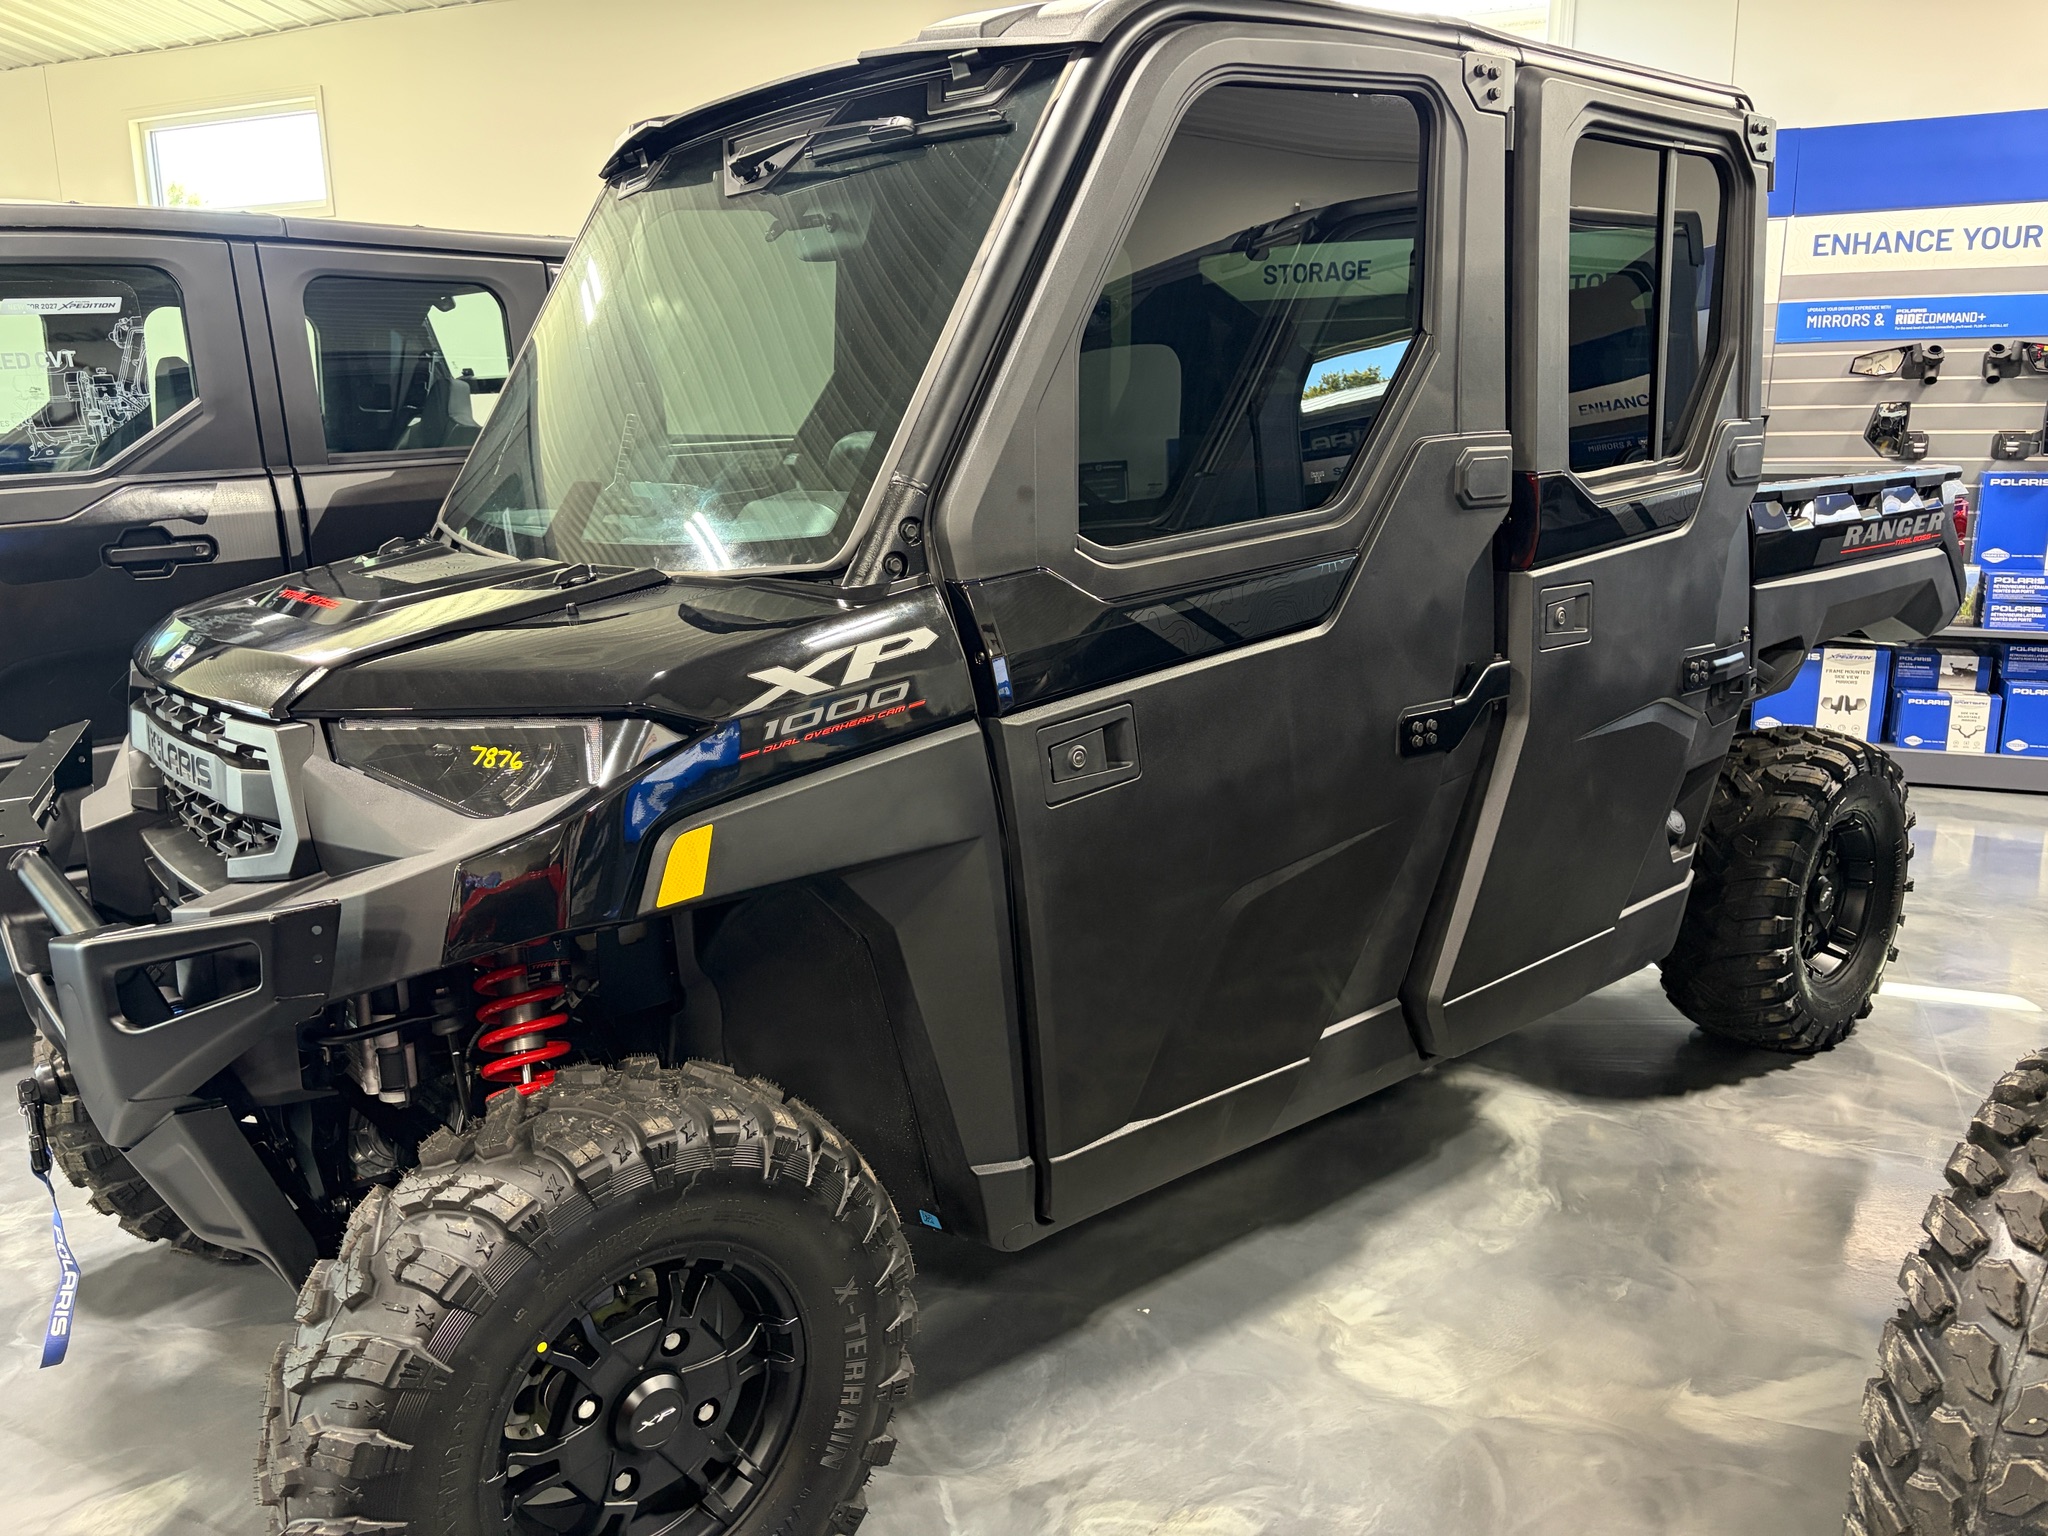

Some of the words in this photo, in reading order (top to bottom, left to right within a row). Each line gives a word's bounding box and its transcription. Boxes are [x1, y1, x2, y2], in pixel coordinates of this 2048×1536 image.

[1812, 228, 1954, 257] ENHANCE
[1963, 224, 2044, 251] YOUR
[1263, 259, 1372, 286] STORAGE
[1569, 272, 1618, 289] TO
[57, 301, 117, 311] XPEDITION
[1895, 311, 1987, 325] RIDECOMMAND+
[1806, 313, 1871, 329] MIRRORS
[1874, 312, 1885, 327] &
[0, 352, 31, 370] ED
[35, 350, 77, 369] CVT
[1842, 511, 1946, 548] RANGER
[1993, 576, 2046, 585] POLARIS
[1990, 605, 2043, 613] POLARIS
[730, 626, 940, 718] XP
[764, 680, 911, 741] 1000
[1907, 698, 1950, 706] POLARIS
[763, 738, 801, 754] DUAL
[803, 713, 876, 742] OVERHEAD
[877, 704, 906, 720] CAM
[148, 722, 213, 791] POLARIS
[470, 745, 524, 770] 7876
[51, 1225, 77, 1337] POLARIS
[820, 1276, 869, 1470] X-TERRAIN
[637, 1407, 677, 1433] XP
